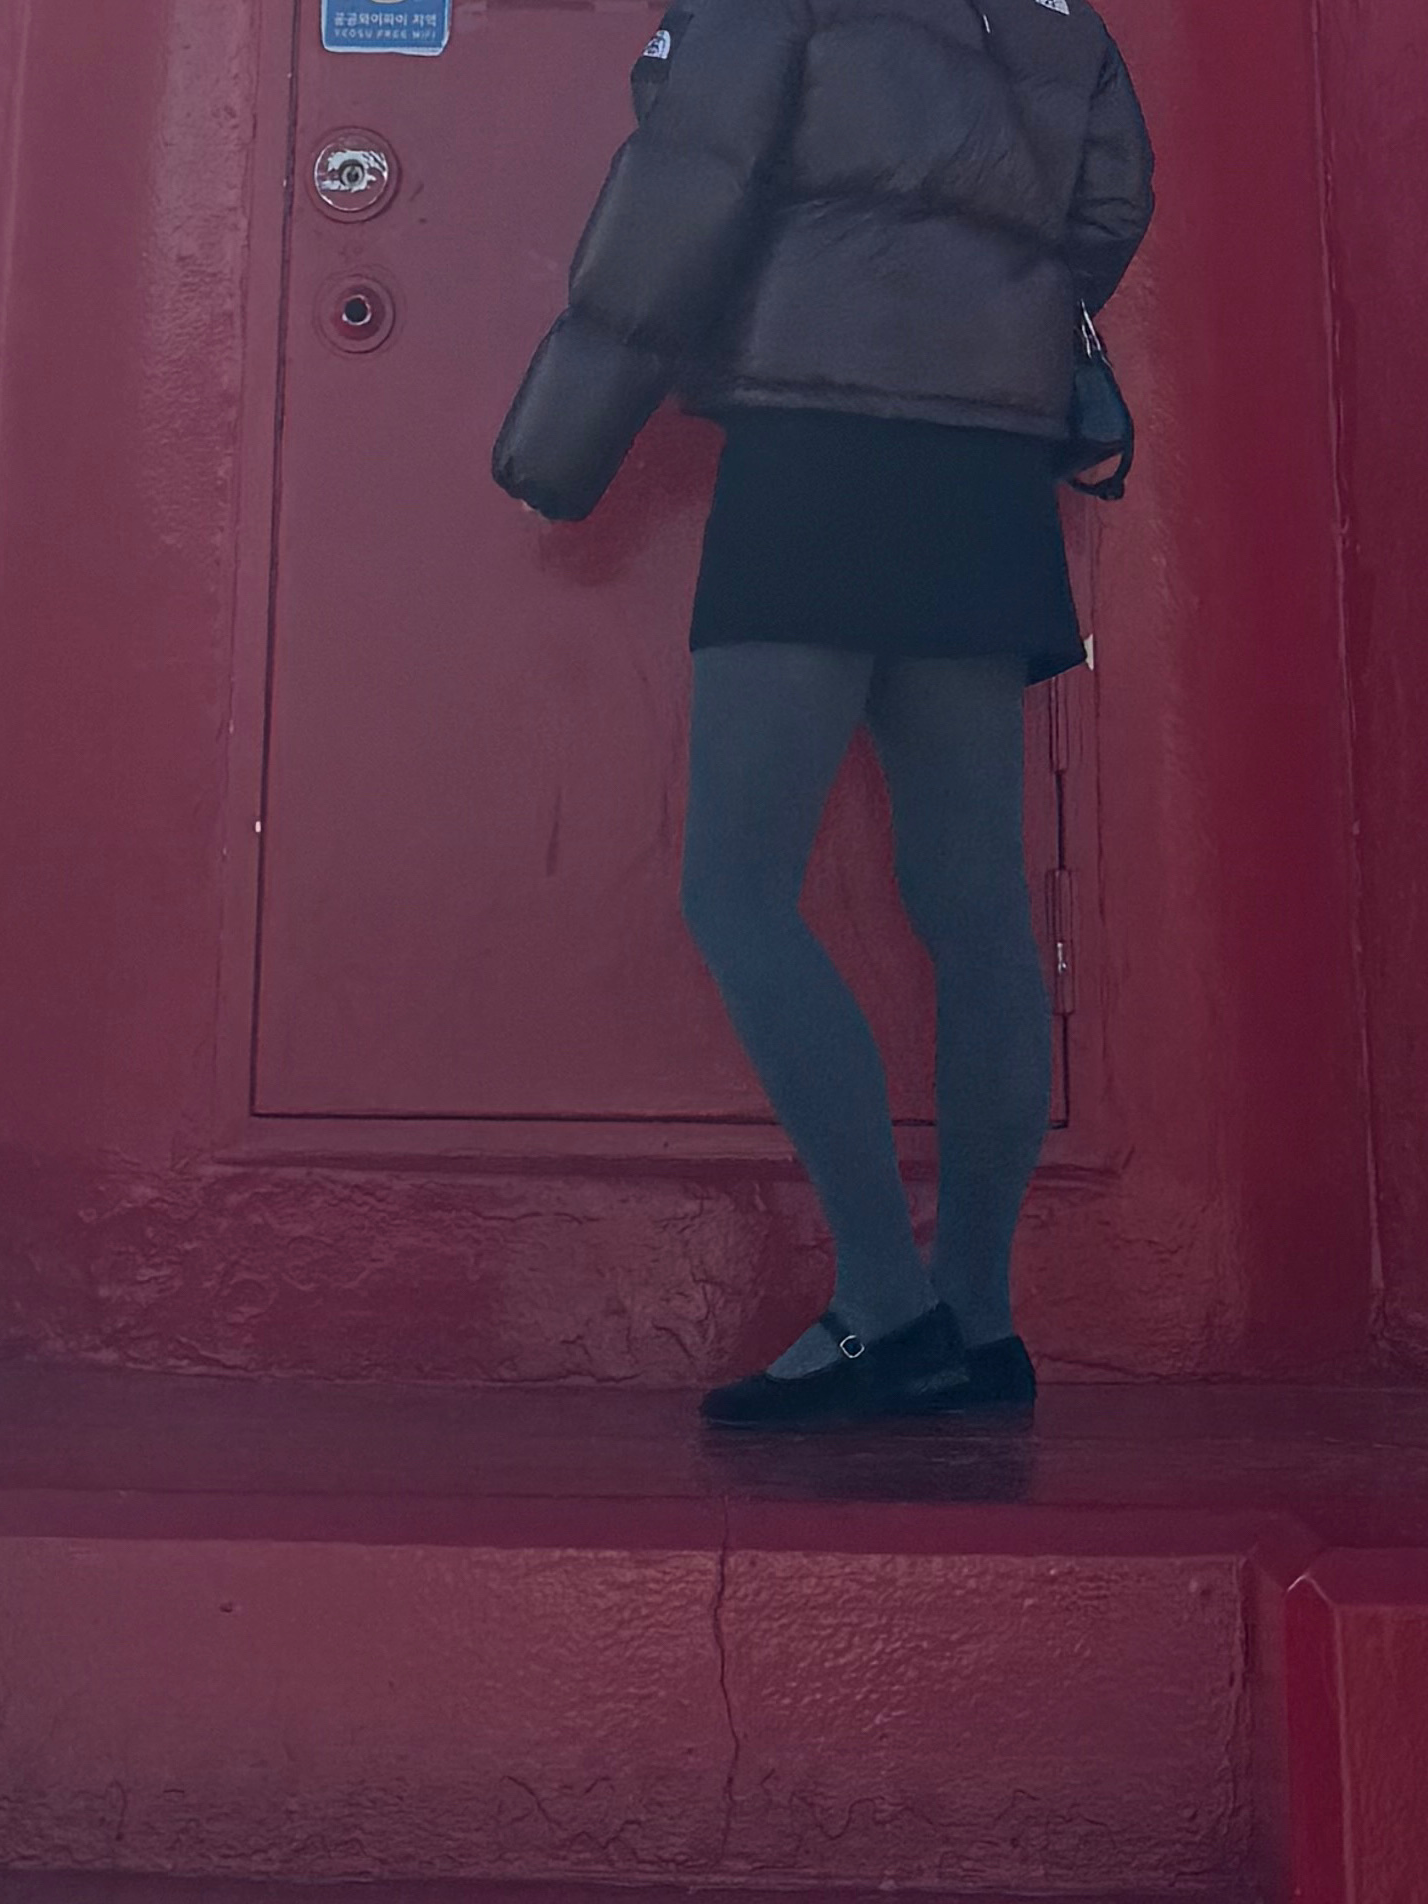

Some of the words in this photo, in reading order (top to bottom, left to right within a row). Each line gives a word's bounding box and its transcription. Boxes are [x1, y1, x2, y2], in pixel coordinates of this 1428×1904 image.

[334, 11, 408, 27] 공공와이파이
[334, 28, 373, 39] YEOSU
[376, 28, 408, 39] FREE
